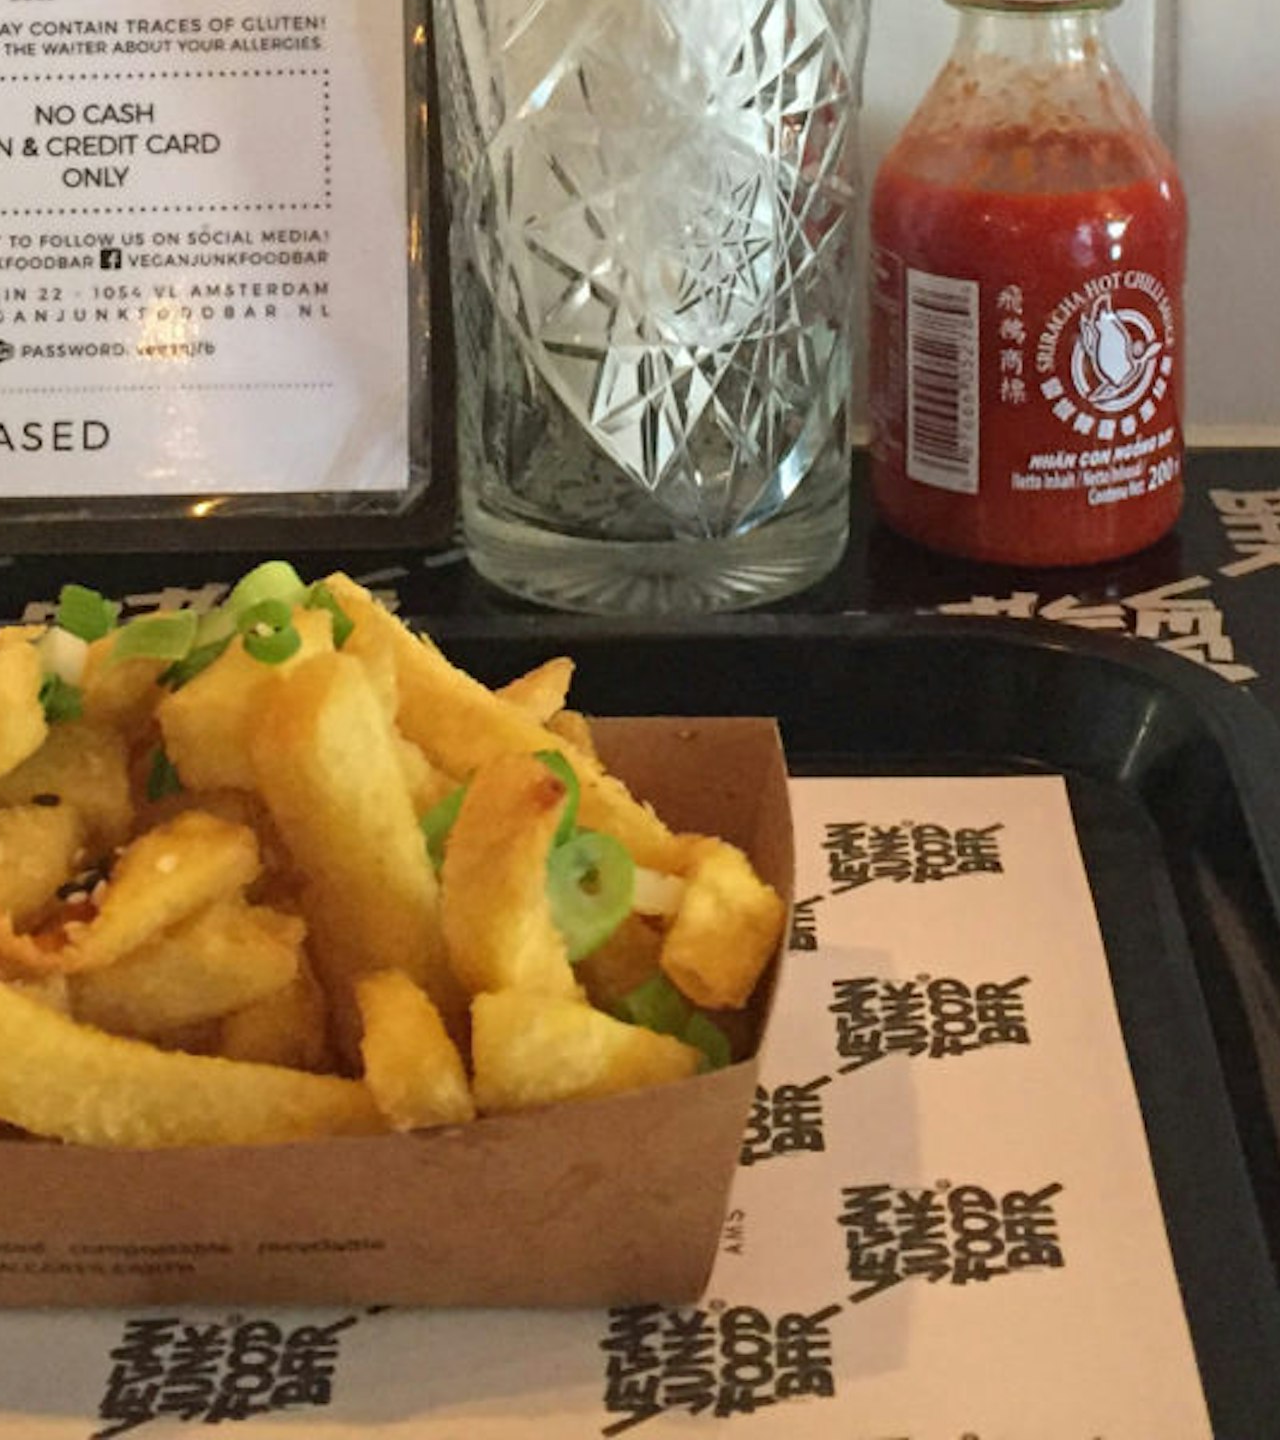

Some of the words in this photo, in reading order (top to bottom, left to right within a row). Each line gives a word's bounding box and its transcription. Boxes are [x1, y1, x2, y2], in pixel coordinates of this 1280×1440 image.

[28, 20, 118, 37] CONTAIN
[126, 18, 202, 34] TRACES
[208, 16, 234, 33] OF
[241, 15, 326, 32] GLUTEN!
[35, 104, 76, 126] NO
[82, 103, 154, 125] CASH
[21, 136, 40, 157] &
[45, 134, 139, 157] CREDIT
[145, 133, 221, 155] CARD
[61, 167, 130, 188] ONLY
[127, 250, 329, 268] VEGANJUNKFOODBAR
[38, 287, 62, 302] 22
[94, 285, 141, 301] 1054
[153, 286, 177, 299] VL
[190, 282, 328, 298] AMSTERDAM
[1083, 272, 1122, 302] HOT
